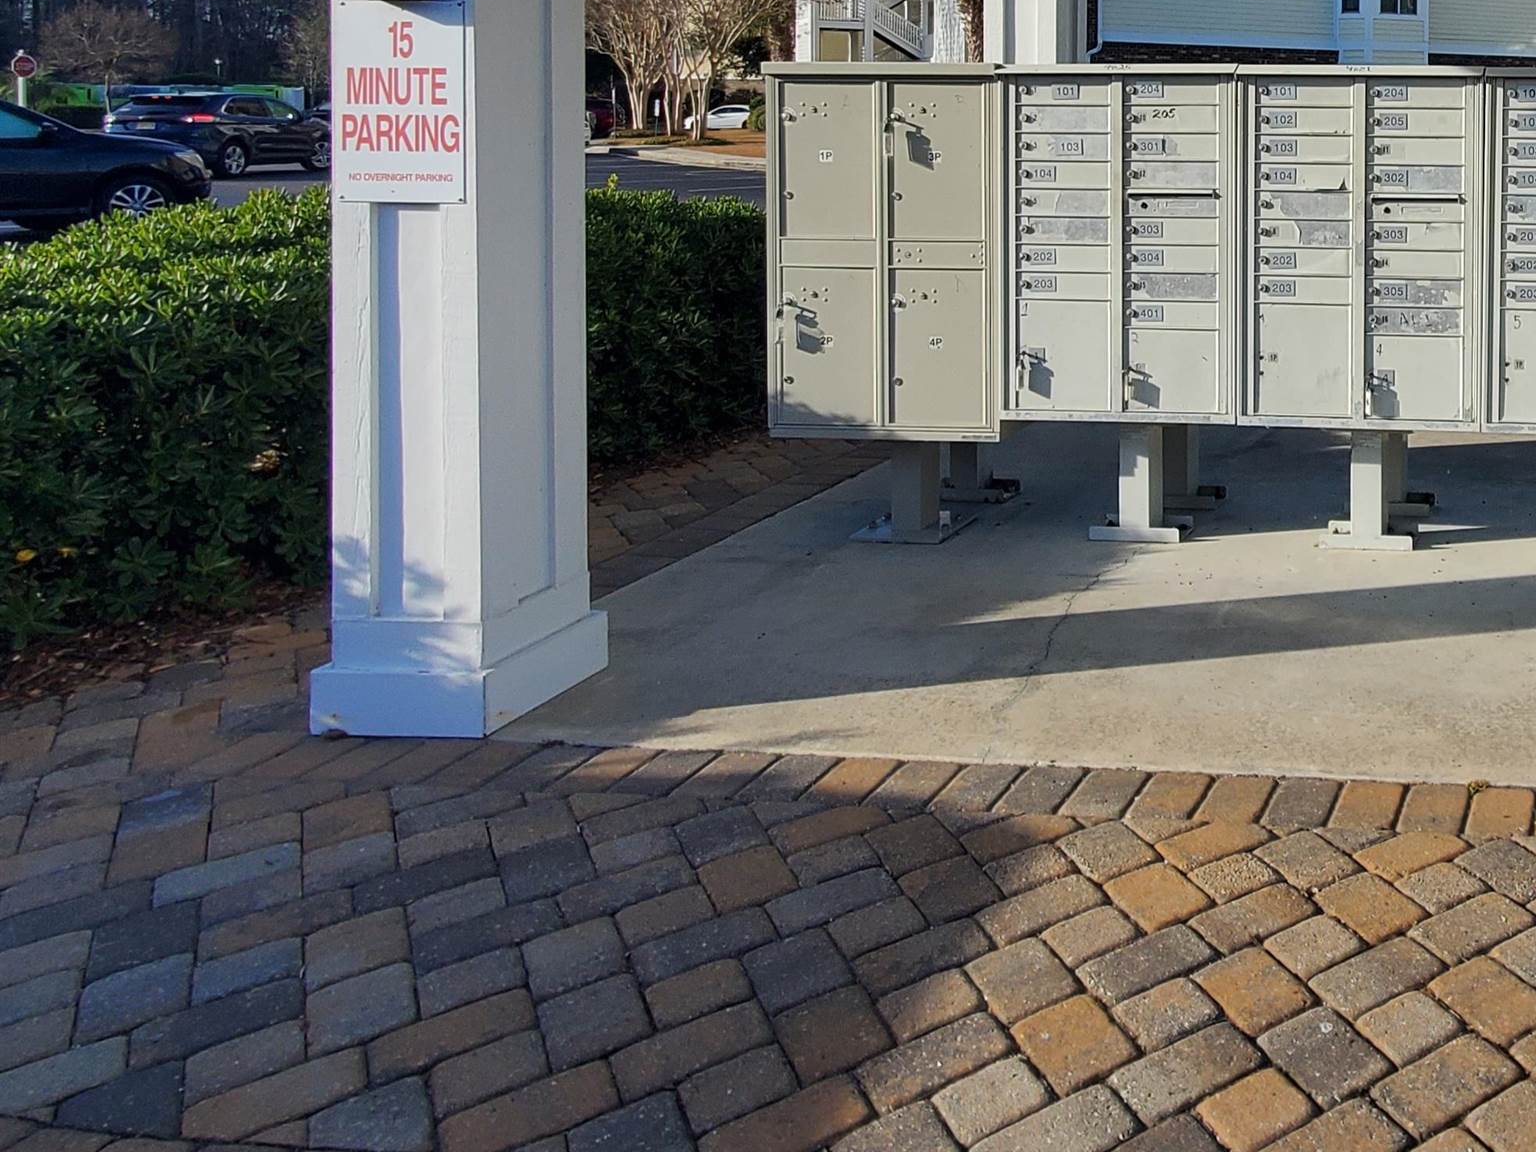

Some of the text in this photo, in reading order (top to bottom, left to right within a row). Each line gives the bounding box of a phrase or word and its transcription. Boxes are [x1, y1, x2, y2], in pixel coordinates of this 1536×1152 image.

[388, 21, 414, 58] 15
[346, 67, 448, 106] MINUTE
[1140, 85, 1160, 94] 204
[1056, 87, 1075, 96] 101
[1274, 88, 1292, 96] 101
[1384, 89, 1403, 97] 204
[1152, 108, 1176, 119] 205
[1274, 116, 1293, 125] 102
[1384, 117, 1403, 126] 205
[341, 113, 460, 153] PARKING
[1061, 143, 1079, 151] 103
[1140, 143, 1159, 151] 301
[1274, 144, 1293, 152] 103
[820, 152, 832, 161] 1P
[929, 153, 941, 161] 3P
[349, 172, 453, 183] NO OVERNIGHT PARKING
[1034, 169, 1051, 178] 104
[1274, 172, 1292, 181] 104
[1384, 173, 1404, 182] 302
[1140, 225, 1159, 234] 303
[1384, 231, 1403, 239] 303
[1033, 253, 1052, 261] 202
[1272, 257, 1292, 265] 202
[1034, 280, 1053, 288] 203
[1272, 284, 1292, 293] 203
[1384, 287, 1403, 296] 305
[1141, 309, 1159, 317] 401
[820, 336, 833, 345] 2P
[930, 338, 942, 347] 4P
